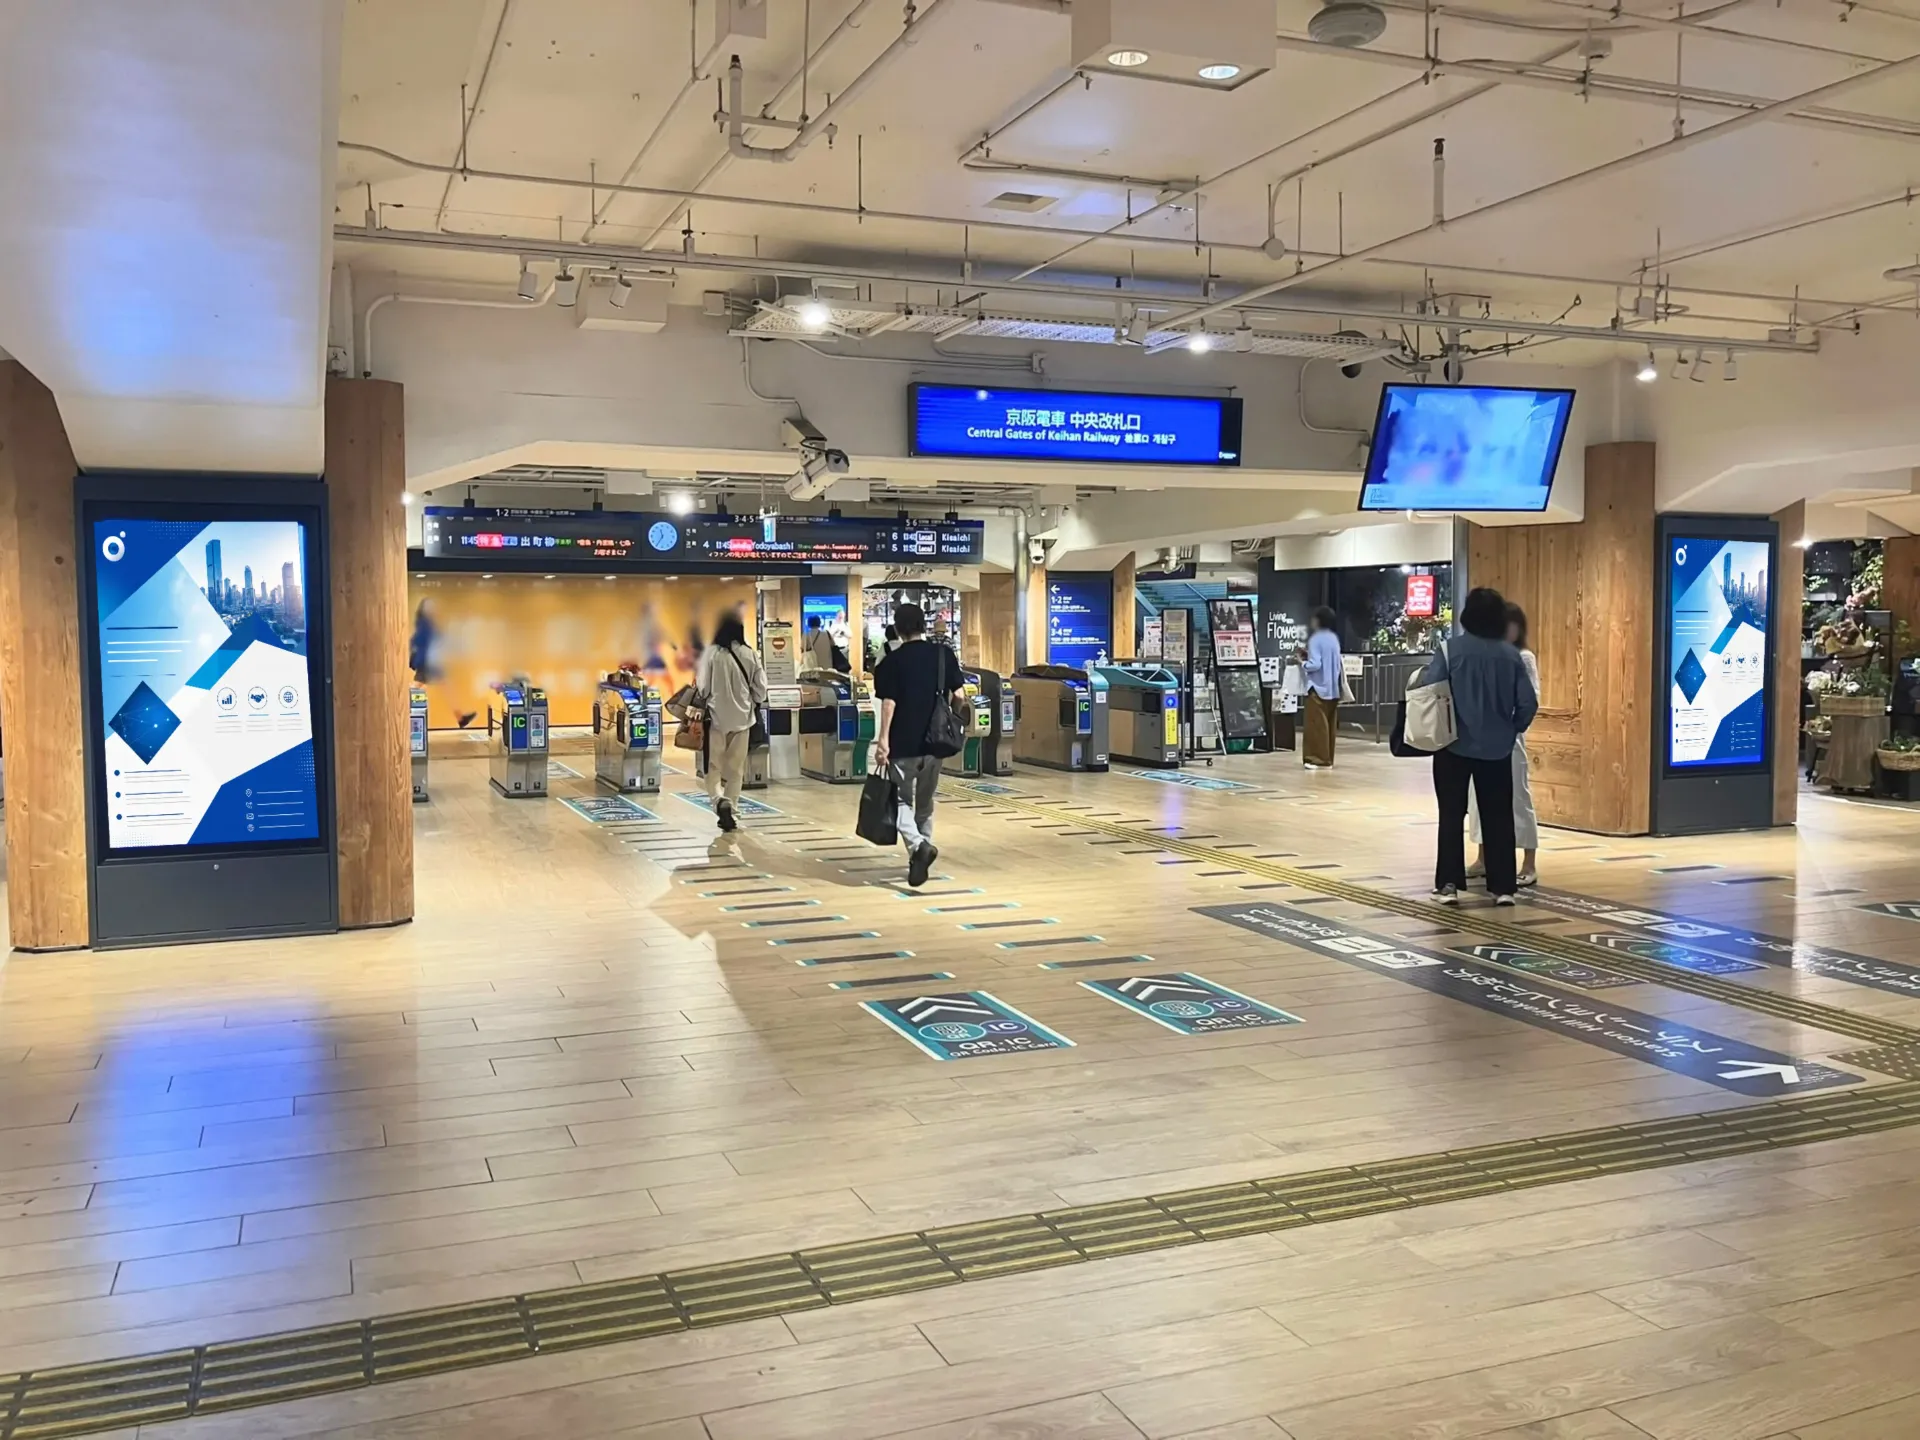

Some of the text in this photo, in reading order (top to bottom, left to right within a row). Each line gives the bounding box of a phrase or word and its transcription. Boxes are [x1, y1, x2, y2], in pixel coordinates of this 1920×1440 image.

[1006, 408, 1141, 431] 京阪電車 中央改札口
[967, 427, 1003, 439] Central
[1005, 428, 1033, 440] Gates
[1035, 429, 1047, 440] of
[1048, 430, 1081, 442] Keihan
[1083, 431, 1121, 445] Railway
[448, 535, 453, 544] 1
[520, 536, 555, 547] 出町柳
[942, 533, 971, 542] Kisaichi
[702, 541, 710, 549] 4
[752, 541, 794, 550] Yodoyabashi
[892, 544, 898, 552] 5
[942, 545, 971, 553] Kisaichi
[1269, 611, 1287, 623] Living
[1267, 622, 1308, 640] Flowers
[1080, 702, 1089, 712] IC
[513, 717, 526, 728] IC
[634, 725, 647, 737] IC
[1213, 1000, 1241, 1008] IC
[988, 1022, 1017, 1031] IC
[1486, 993, 1684, 1058] Station Hill Hirakata
[950, 1050, 970, 1058] QR
[973, 1047, 1010, 1056] Code,
[1028, 1041, 1058, 1049] Card
